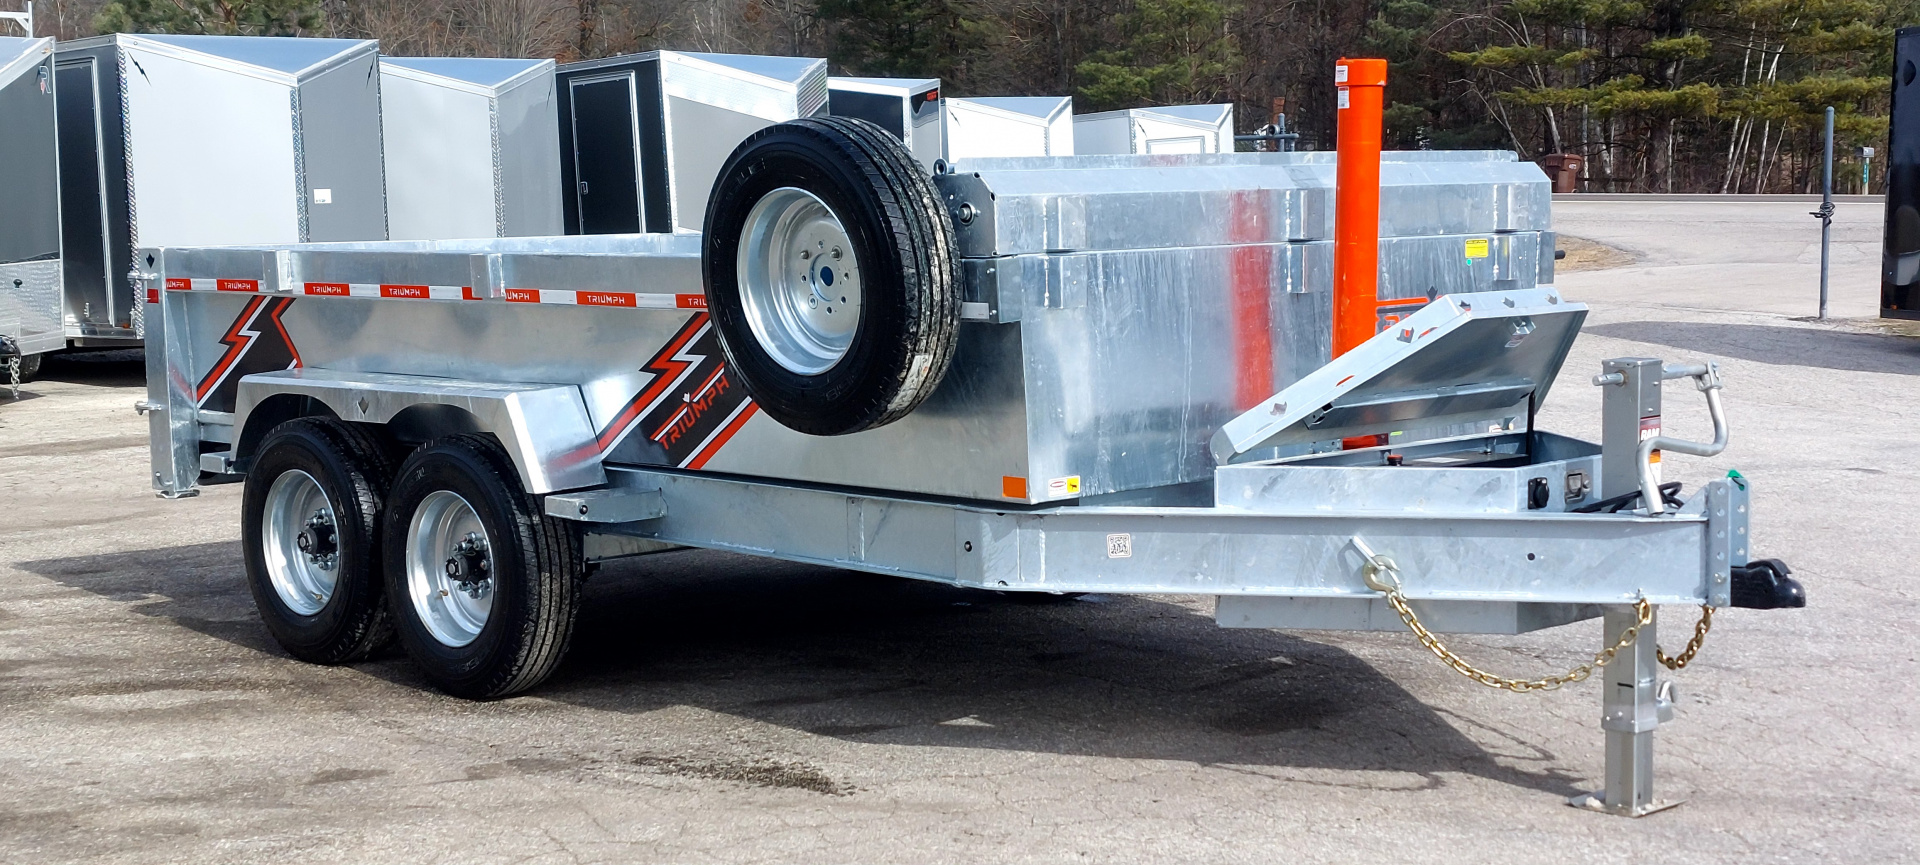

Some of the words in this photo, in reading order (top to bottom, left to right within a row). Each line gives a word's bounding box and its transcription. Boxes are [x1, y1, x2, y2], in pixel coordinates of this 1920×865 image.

[224, 282, 251, 290] TRIUMPH
[312, 286, 342, 294] TRIUMPH
[388, 287, 421, 296] TRIUMPH
[587, 294, 626, 304] TRIUMPH
[659, 374, 730, 450] TRIUMPH
[1641, 428, 1660, 440] RAM
